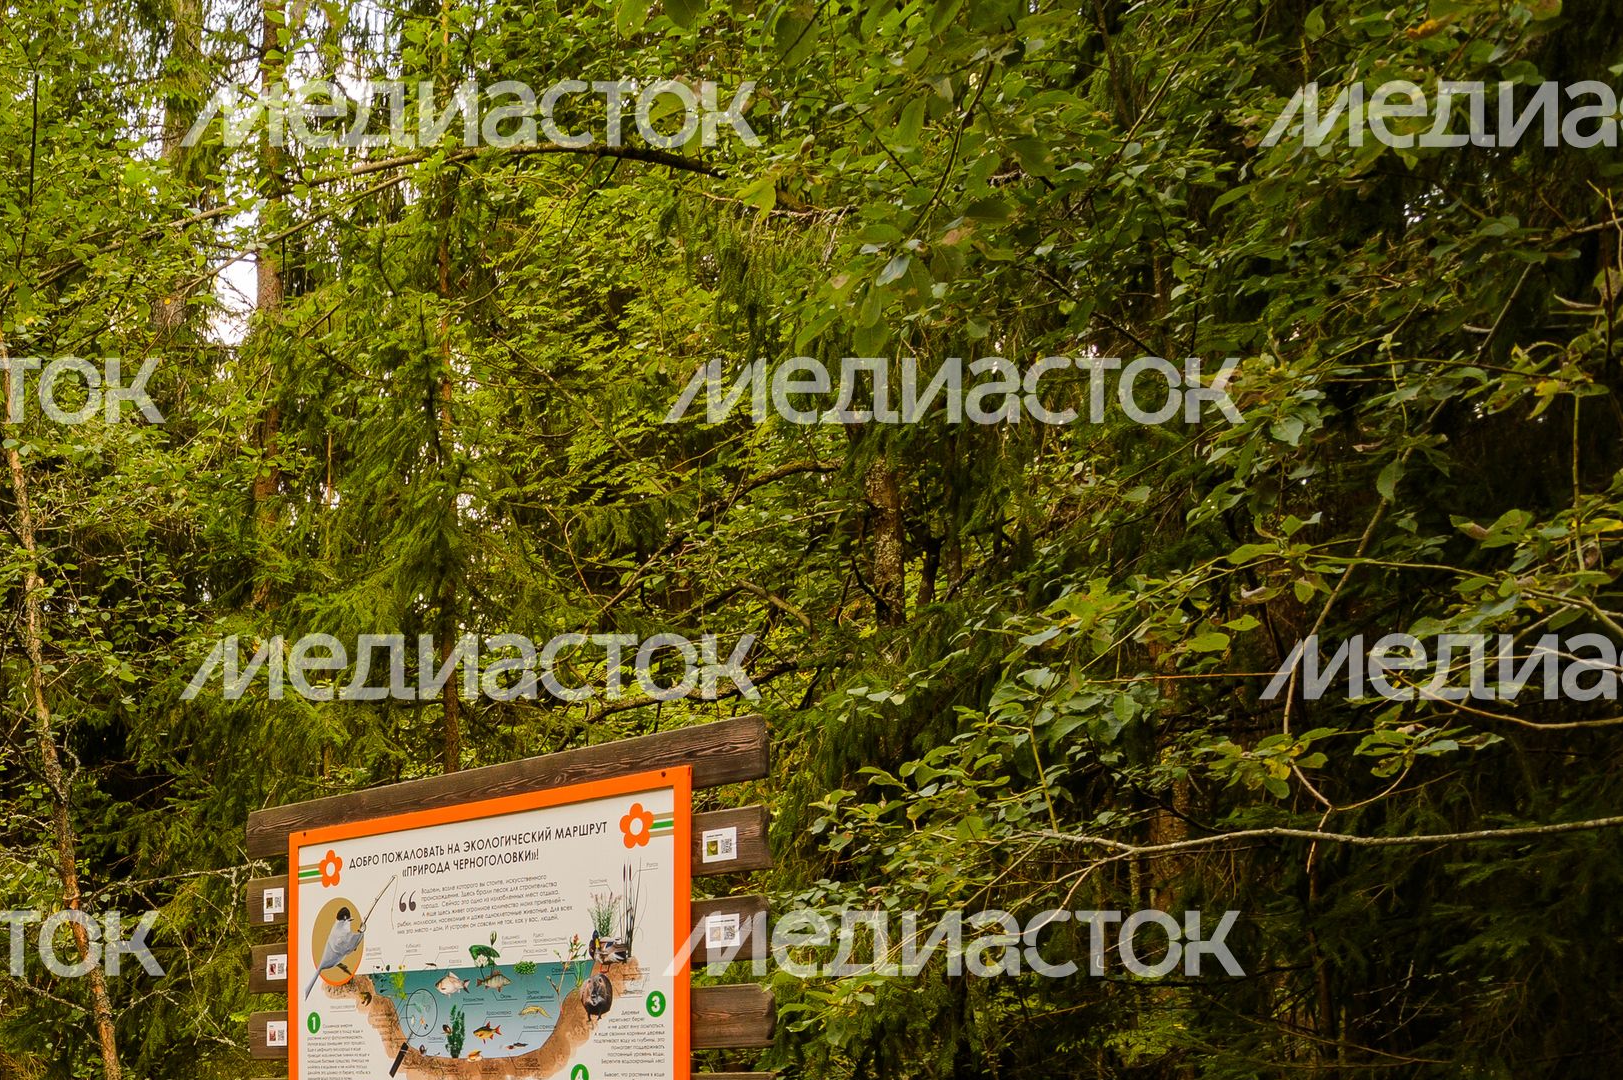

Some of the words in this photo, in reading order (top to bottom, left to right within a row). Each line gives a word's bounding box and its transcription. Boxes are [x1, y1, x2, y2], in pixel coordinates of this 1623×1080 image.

[348, 854, 379, 869] ДОБРО
[382, 845, 444, 864] ПОЖАЛОВАТЬ
[448, 842, 460, 855] НА
[464, 827, 551, 853] ЭКОЛОГИЧЕСКИЙ
[555, 821, 607, 840] МАРШРУТ
[402, 860, 450, 877] «ПРИРОДА
[453, 848, 539, 871] ЧЕРНОГОЛОВКИ»!
[651, 996, 661, 1012] 3
[312, 1017, 316, 1030] 1
